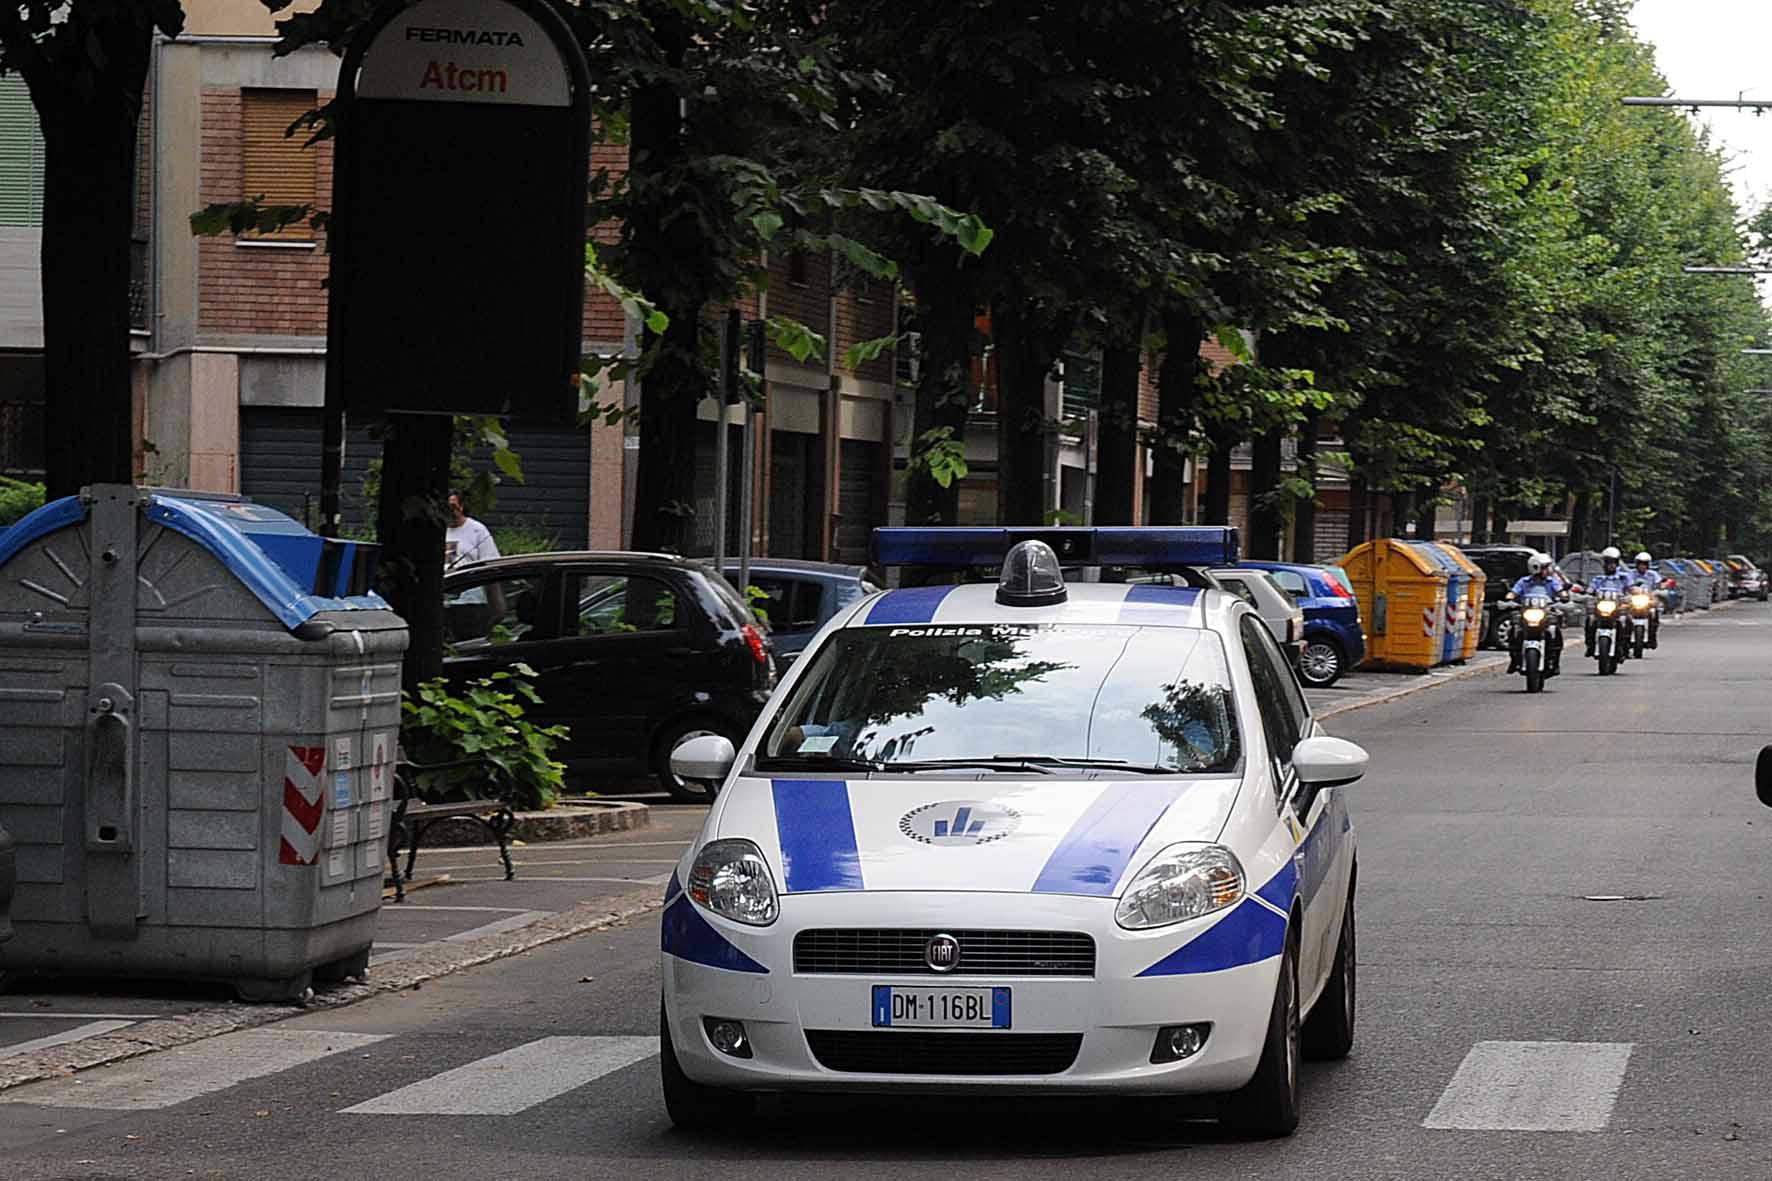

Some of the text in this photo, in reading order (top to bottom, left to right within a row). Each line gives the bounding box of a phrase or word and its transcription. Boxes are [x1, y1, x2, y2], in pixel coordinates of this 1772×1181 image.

[405, 27, 524, 47] FERMATA
[419, 60, 508, 93] Atcm
[889, 627, 983, 637] Polizia
[932, 945, 953, 961] FIAT
